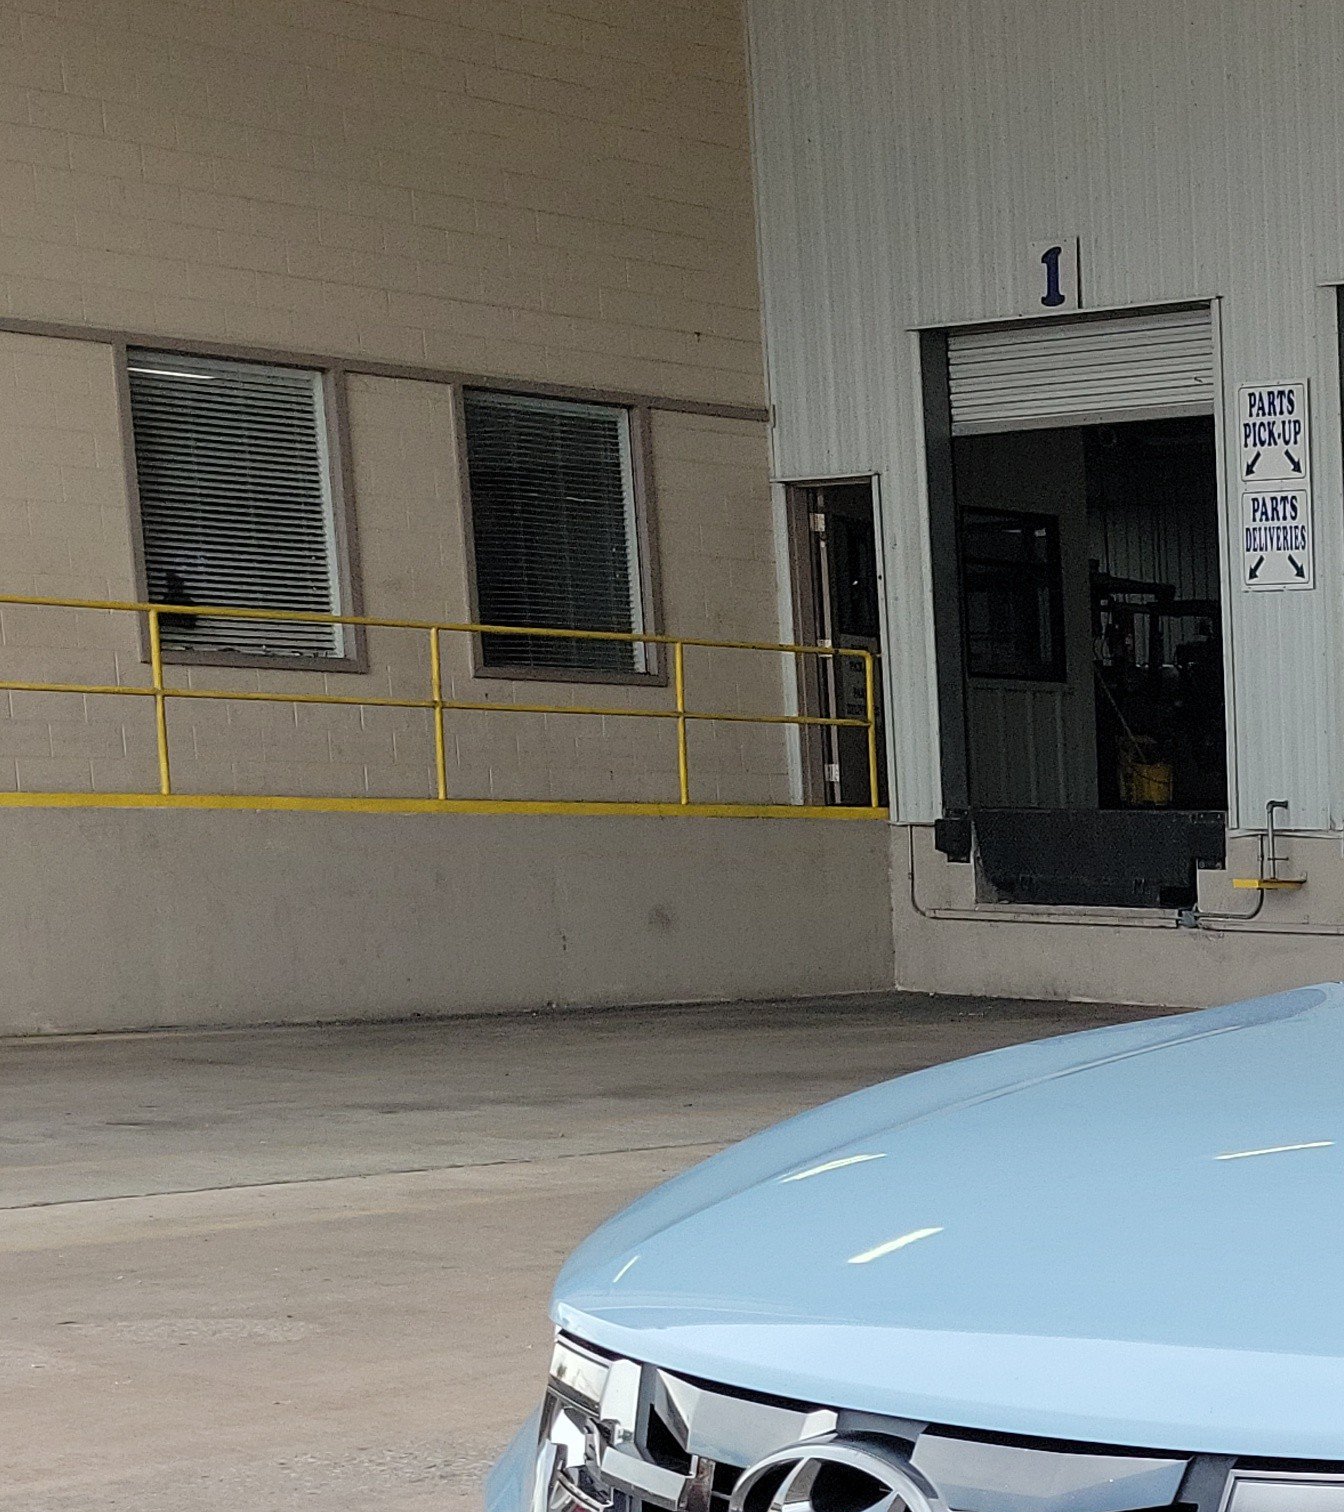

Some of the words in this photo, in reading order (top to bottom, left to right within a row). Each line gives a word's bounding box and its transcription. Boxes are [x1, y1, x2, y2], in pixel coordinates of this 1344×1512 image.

[1041, 246, 1065, 306] 1
[1248, 389, 1295, 418] PARTS
[1243, 419, 1302, 448] PICK-UP
[1251, 495, 1298, 522] PARTS
[1245, 525, 1307, 552] DELIVERIES
